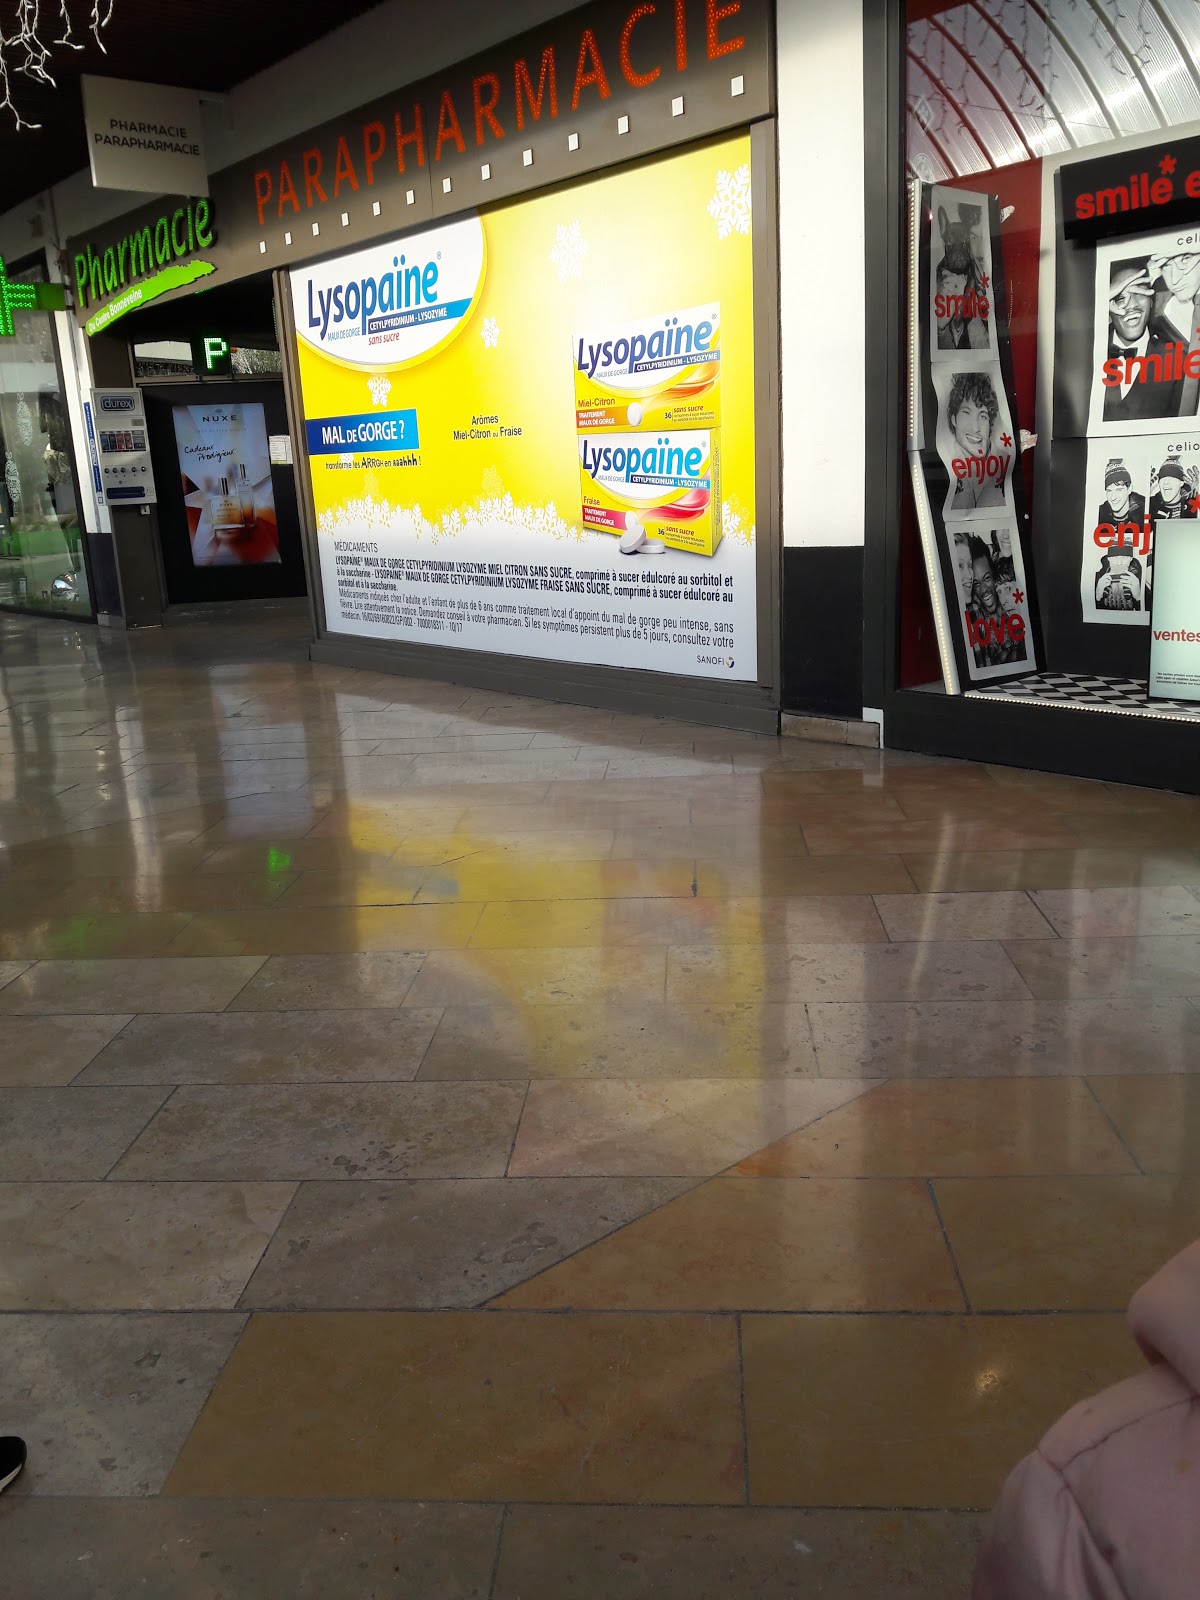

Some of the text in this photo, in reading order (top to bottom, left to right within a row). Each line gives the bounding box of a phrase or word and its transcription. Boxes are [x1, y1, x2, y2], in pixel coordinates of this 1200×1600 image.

[254, 0, 745, 225] PARAPHARMACIE
[109, 118, 187, 138] PHARMACIE
[94, 133, 200, 155] PARAPHARMACIE
[1075, 172, 1173, 219] smile
[74, 195, 213, 307] Pharmacie
[934, 287, 990, 318] smile
[369, 307, 447, 330] CETYLPYRIDINIUM LYSOZYME
[346, 327, 360, 338] GORGE
[368, 332, 400, 345] sans sucre
[636, 353, 718, 371] CETYLPYRIDINIUM LYSOZYME
[1102, 341, 1200, 387] smile
[104, 398, 132, 409] durex
[578, 397, 615, 407] Miel-Citron
[202, 414, 238, 422] NUXE
[472, 415, 498, 425] Arômes
[322, 420, 404, 444] MAL DE GORGE ?
[454, 429, 491, 440] Miel-Citron
[500, 426, 522, 436] Fraise
[184, 444, 214, 453] Cadeaux
[326, 460, 352, 470] transforme
[352, 460, 360, 468] les
[361, 456, 384, 469] ARRGH
[952, 450, 1011, 484] enjoy
[632, 476, 707, 488] CETYLPYRIDINIUM LYSOZYME
[583, 496, 600, 506] Fraise
[334, 539, 378, 553] MÉDICAMENTS
[364, 557, 733, 587] MAUX DE GORGE CETYLPYRIDINIUM LYSOZYME MIEL CITRON SANS SUCRE, comprimé à sucer édulcoré au sorbitol et
[338, 577, 354, 587] sorbitol
[355, 580, 360, 588] et
[365, 580, 370, 589] la
[341, 567, 345, 576] la
[346, 568, 371, 578] saccharine
[406, 571, 421, 582] MAUX
[422, 572, 430, 582] DE
[431, 573, 449, 584] GORGE
[451, 574, 504, 587] CETYLPYRIDINIUM
[505, 577, 539, 590] LYSOZYME
[540, 580, 563, 592] FRAISE
[565, 581, 584, 594] SANS
[586, 582, 612, 596] SUCRE,
[614, 585, 650, 599] comprimé
[653, 586, 657, 598] à
[660, 589, 681, 599] sucer
[684, 587, 720, 601] édulcoré
[722, 592, 733, 602] au
[422, 596, 427, 605] et
[448, 598, 455, 608] de
[457, 599, 468, 611] plus
[470, 600, 477, 610] de
[484, 603, 494, 612] ans
[495, 604, 516, 614] comme
[518, 604, 549, 617] traitement
[551, 606, 566, 618] local
[569, 608, 599, 622] d'appoint
[601, 611, 610, 622] du
[612, 612, 625, 624] mal
[628, 613, 636, 624] de
[639, 617, 660, 630] gorge
[663, 618, 677, 630] peu
[679, 616, 712, 633] intense,
[714, 622, 733, 633] sans
[419, 606, 445, 619] Demandez
[446, 611, 465, 621] conseil
[471, 614, 486, 624] votre
[487, 614, 523, 626] pharmacien.
[524, 616, 530, 628] Si
[532, 618, 541, 629] les
[542, 620, 578, 633] symptômes
[580, 623, 614, 636] persistent
[616, 626, 630, 639] plus
[632, 627, 641, 639] de
[643, 628, 648, 640] 5
[649, 628, 671, 643] jours,
[672, 633, 710, 646] consultez
[712, 636, 734, 648] votre
[965, 611, 1026, 648] love
[1153, 628, 1200, 642] ventes
[697, 655, 724, 665] SANOFI
